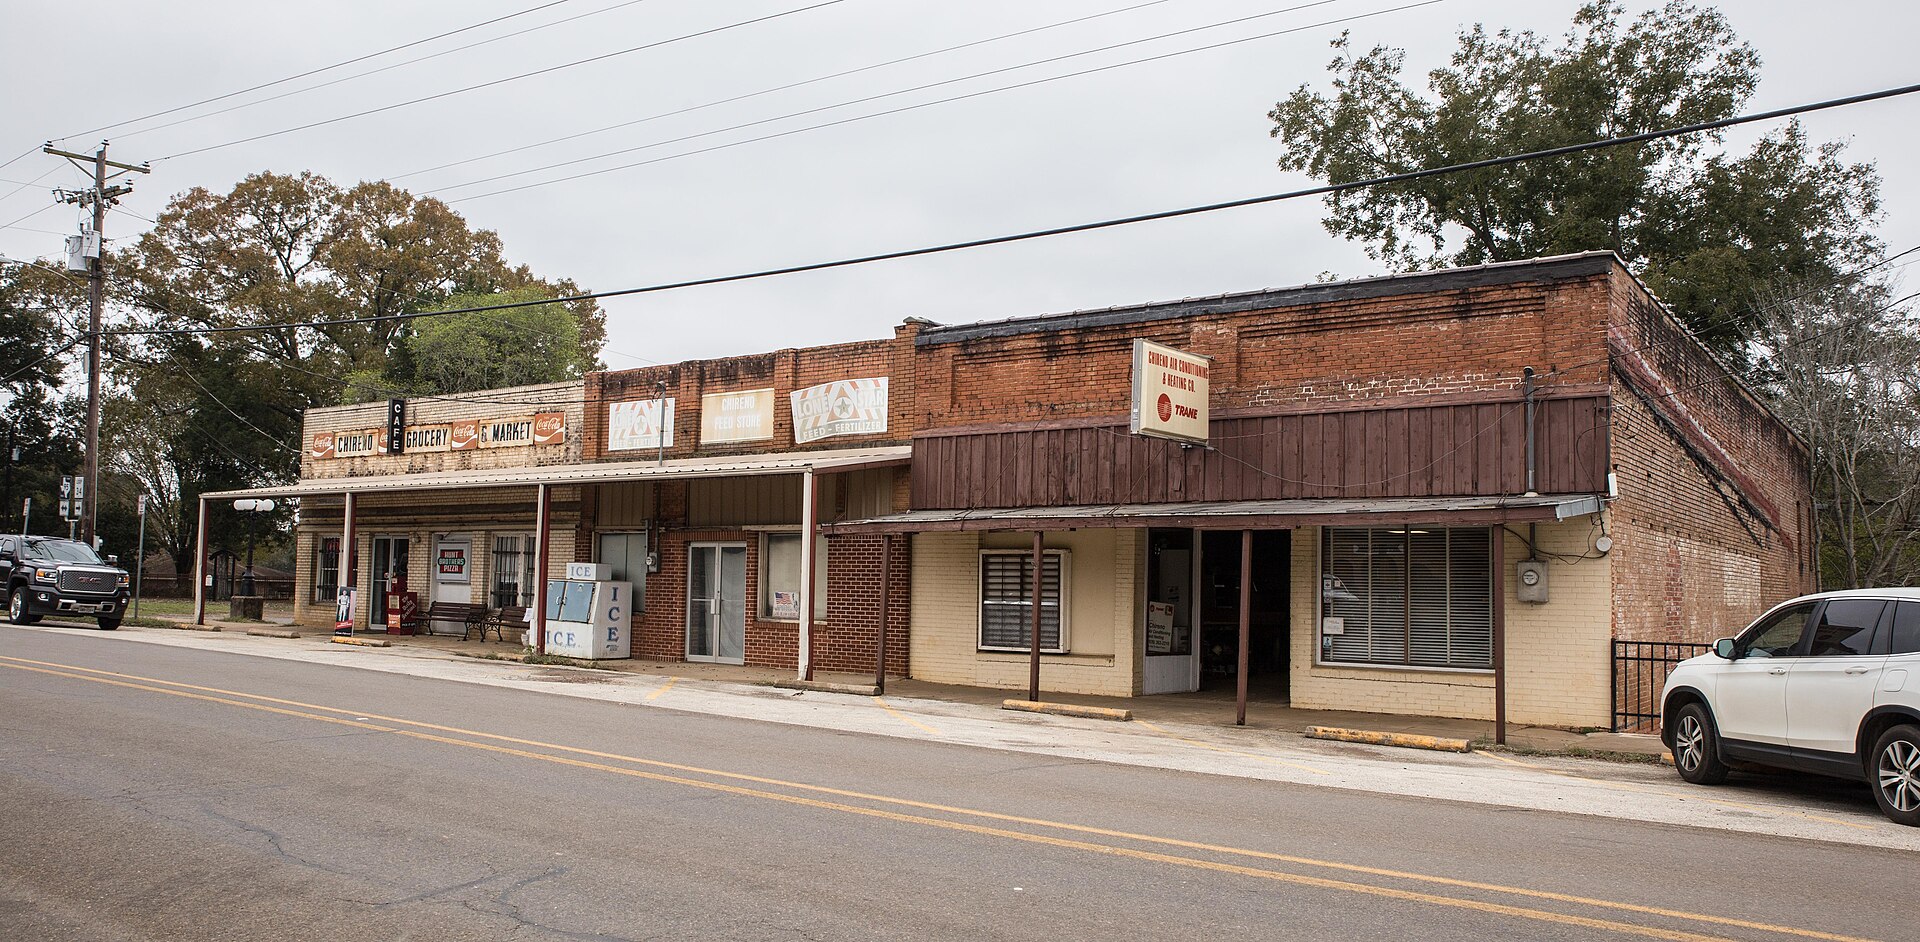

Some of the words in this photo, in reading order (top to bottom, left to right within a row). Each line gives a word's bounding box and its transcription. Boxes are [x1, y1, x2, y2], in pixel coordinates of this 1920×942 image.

[1148, 351, 1168, 368] CHIRENO
[1179, 359, 1209, 379] CONDITIONING
[1162, 372, 1166, 385] &
[1167, 373, 1187, 390] HEATING
[1188, 379, 1196, 392] CO.
[722, 396, 755, 411] CHIRENO
[797, 393, 829, 419] LONE
[857, 388, 884, 409] STAR
[1175, 404, 1198, 419] TRANE
[393, 403, 401, 450] CAFE
[714, 415, 733, 430] FEED
[803, 427, 826, 439] FEED
[835, 421, 881, 432] FERTILIZER
[338, 435, 373, 453] CHIRENO
[406, 428, 448, 449] GROCERY
[481, 425, 488, 443] &
[492, 421, 532, 442] MARKET
[443, 564, 459, 572] PIZZA
[570, 566, 591, 577] ICE
[607, 586, 620, 642] ICE
[546, 630, 576, 647] ICE
